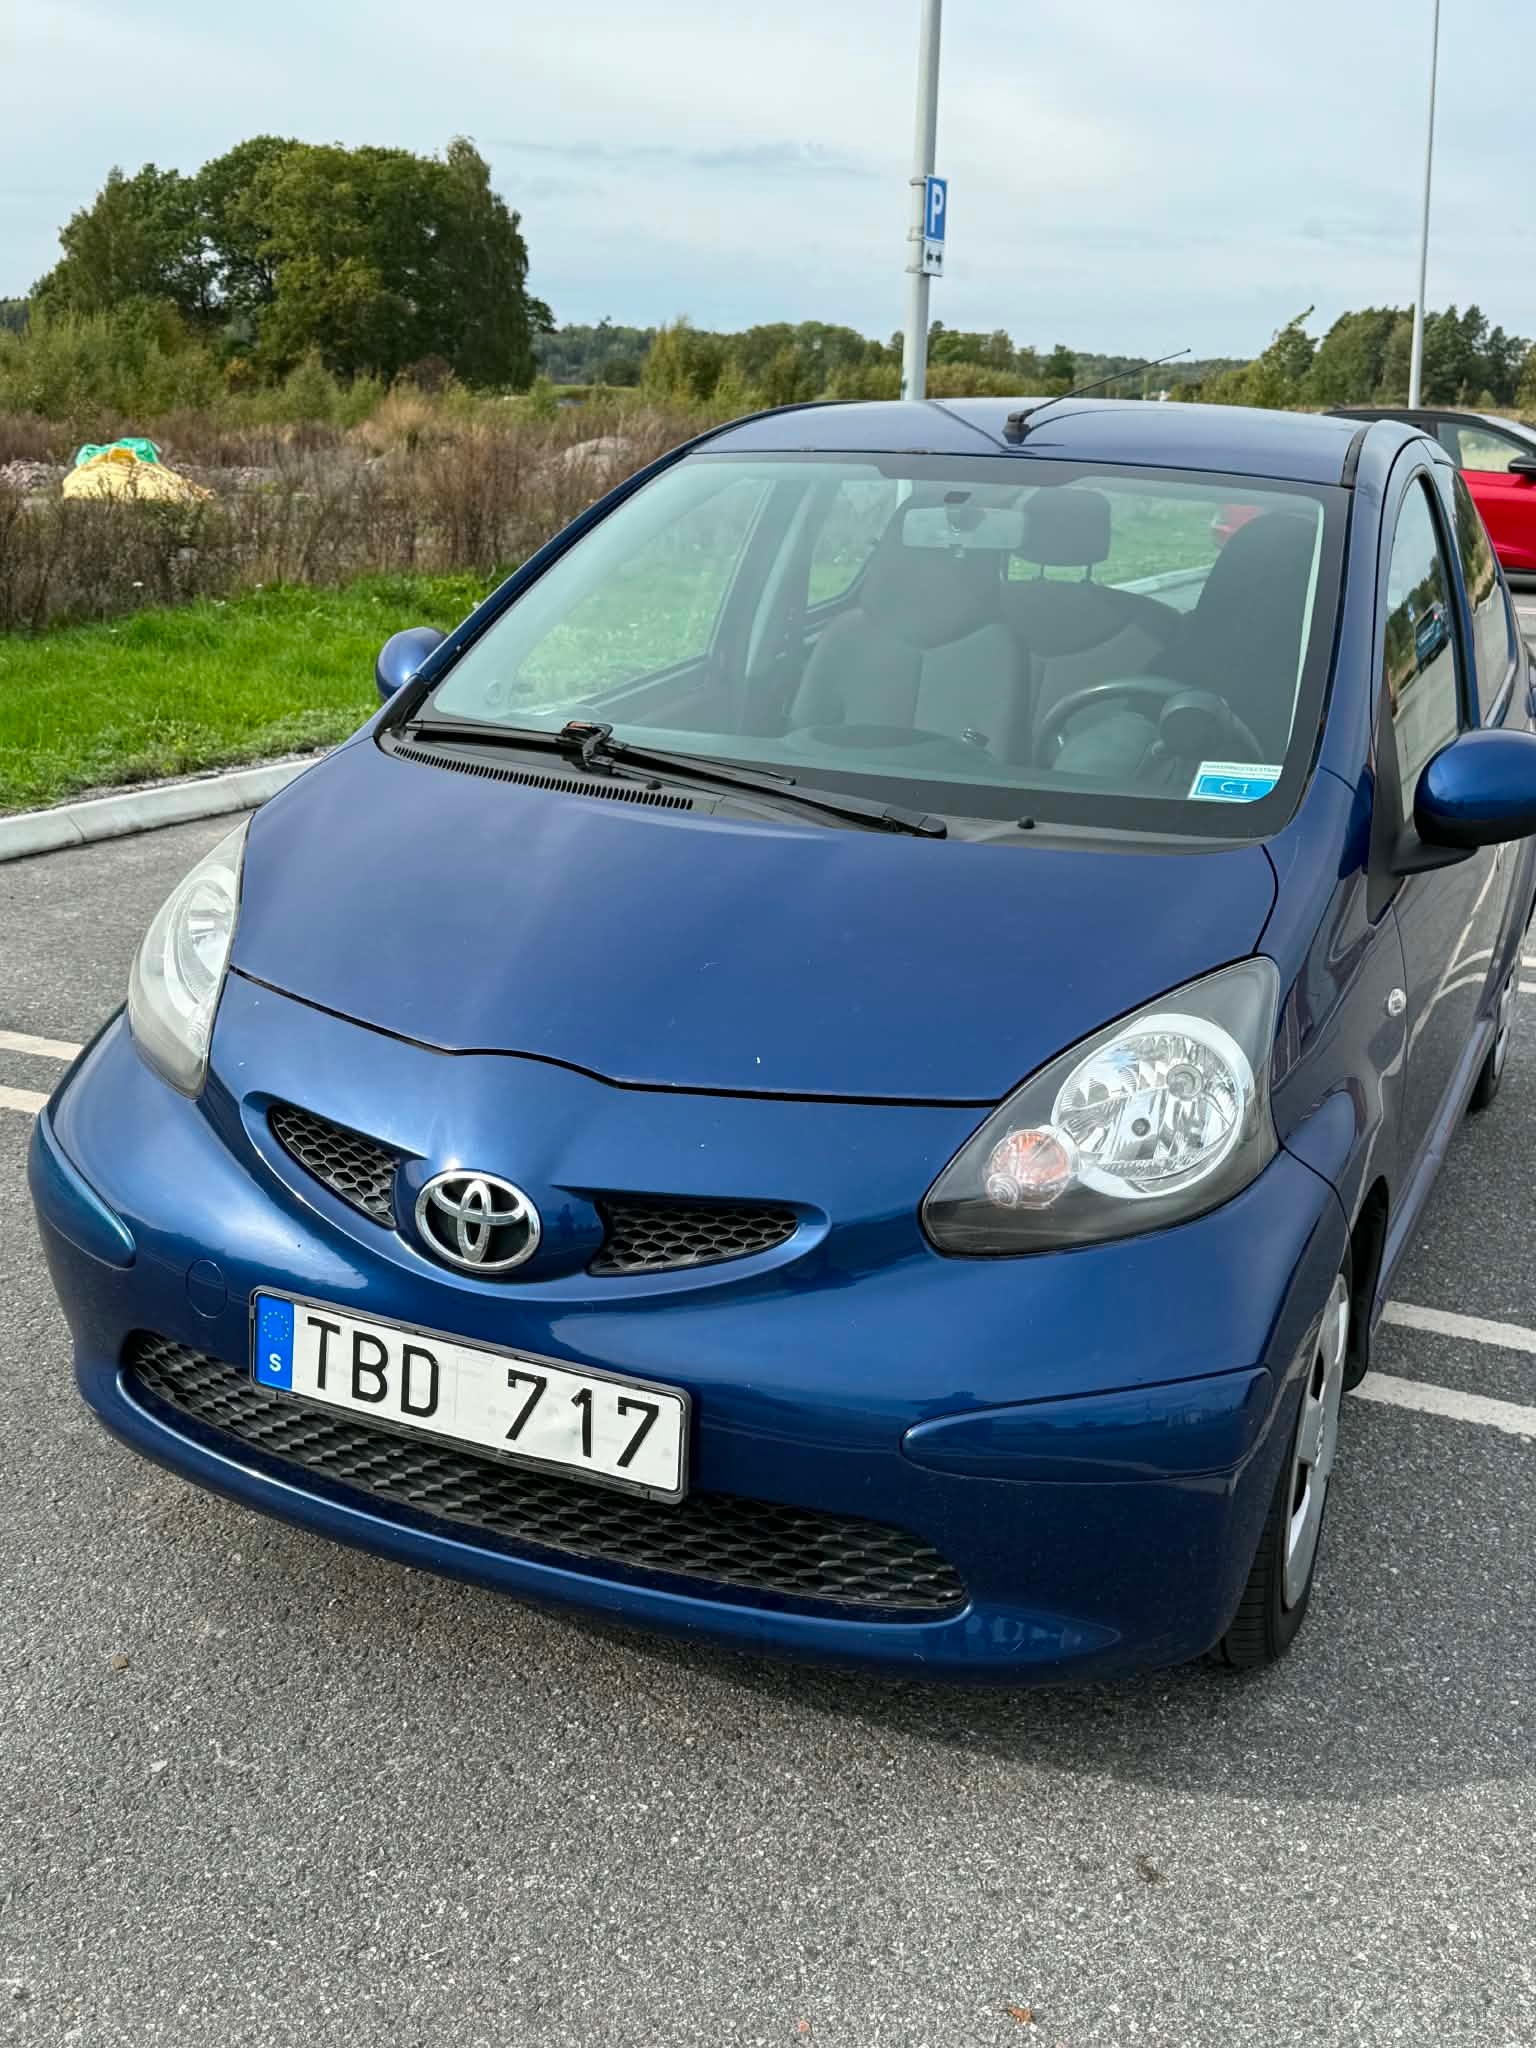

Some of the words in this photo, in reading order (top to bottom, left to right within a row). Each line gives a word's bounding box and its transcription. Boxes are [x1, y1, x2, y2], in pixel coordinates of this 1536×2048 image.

[930, 183, 945, 233] P
[269, 1353, 281, 1372] S
[307, 1316, 439, 1418] TBD
[505, 1368, 660, 1468] 717
